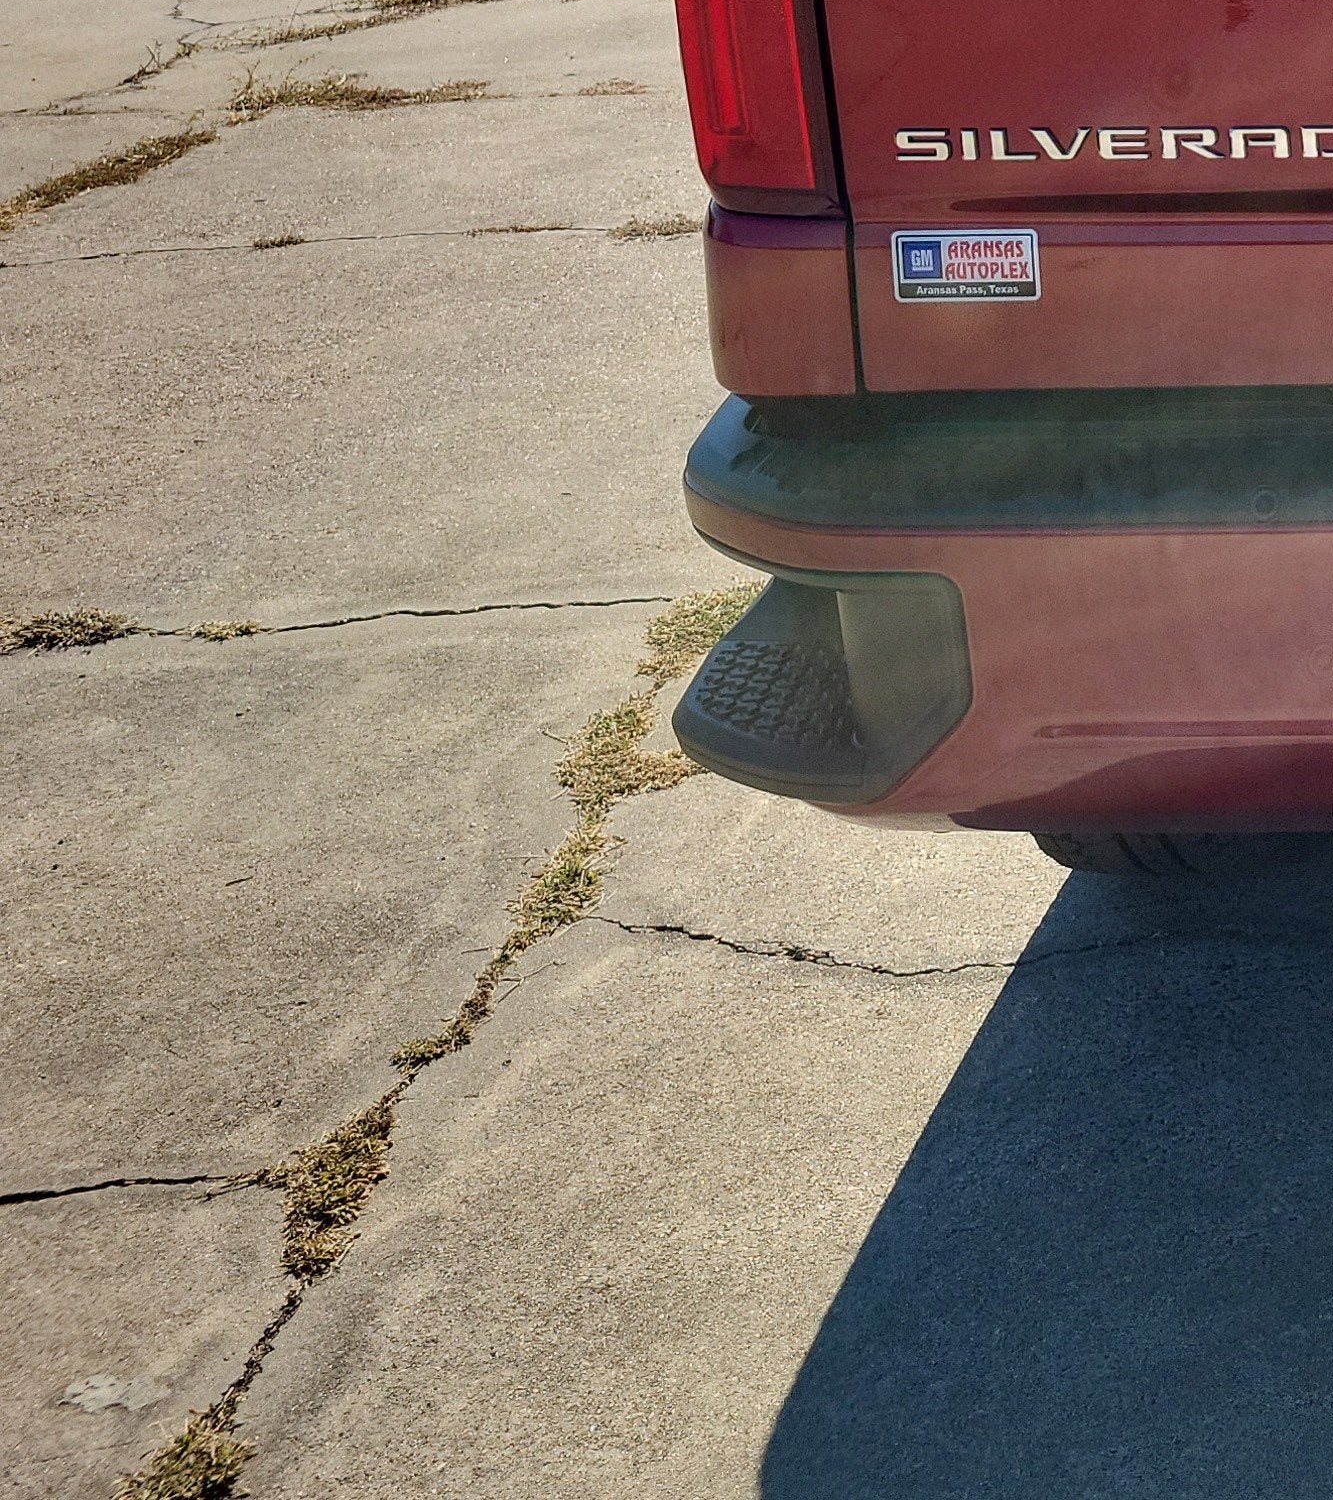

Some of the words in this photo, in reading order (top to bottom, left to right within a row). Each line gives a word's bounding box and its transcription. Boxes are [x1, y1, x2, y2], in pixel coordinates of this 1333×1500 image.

[947, 240, 1025, 260] ARANSAS
[911, 249, 934, 271] GM
[944, 261, 1030, 280] AUTOPLEX
[916, 286, 957, 296] Aransas
[959, 285, 987, 296] Pass,
[989, 285, 1019, 295] Texas
